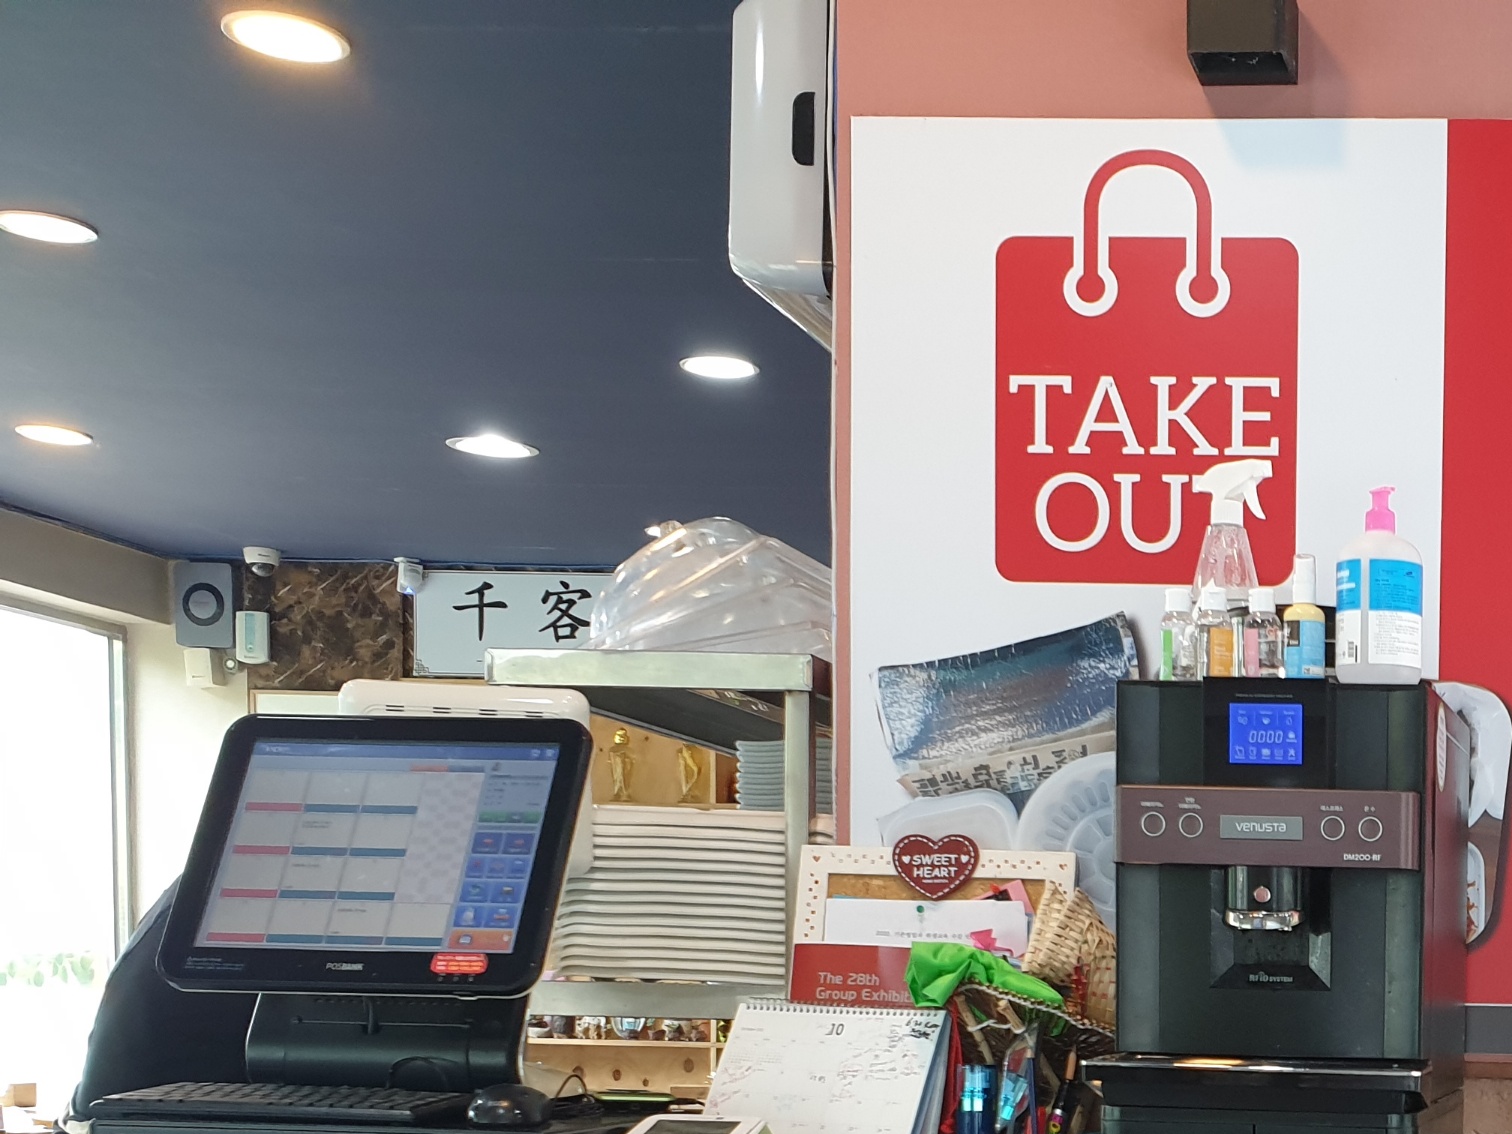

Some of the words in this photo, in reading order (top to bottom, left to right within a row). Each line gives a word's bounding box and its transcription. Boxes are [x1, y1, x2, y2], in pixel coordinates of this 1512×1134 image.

[1008, 375, 1281, 457] TAKE
[911, 854, 959, 866] SWEET
[912, 867, 959, 878] HEART
[818, 972, 843, 985] The
[847, 972, 880, 986] 28th
[816, 987, 858, 1001] Group
[825, 1023, 845, 1036] 10
